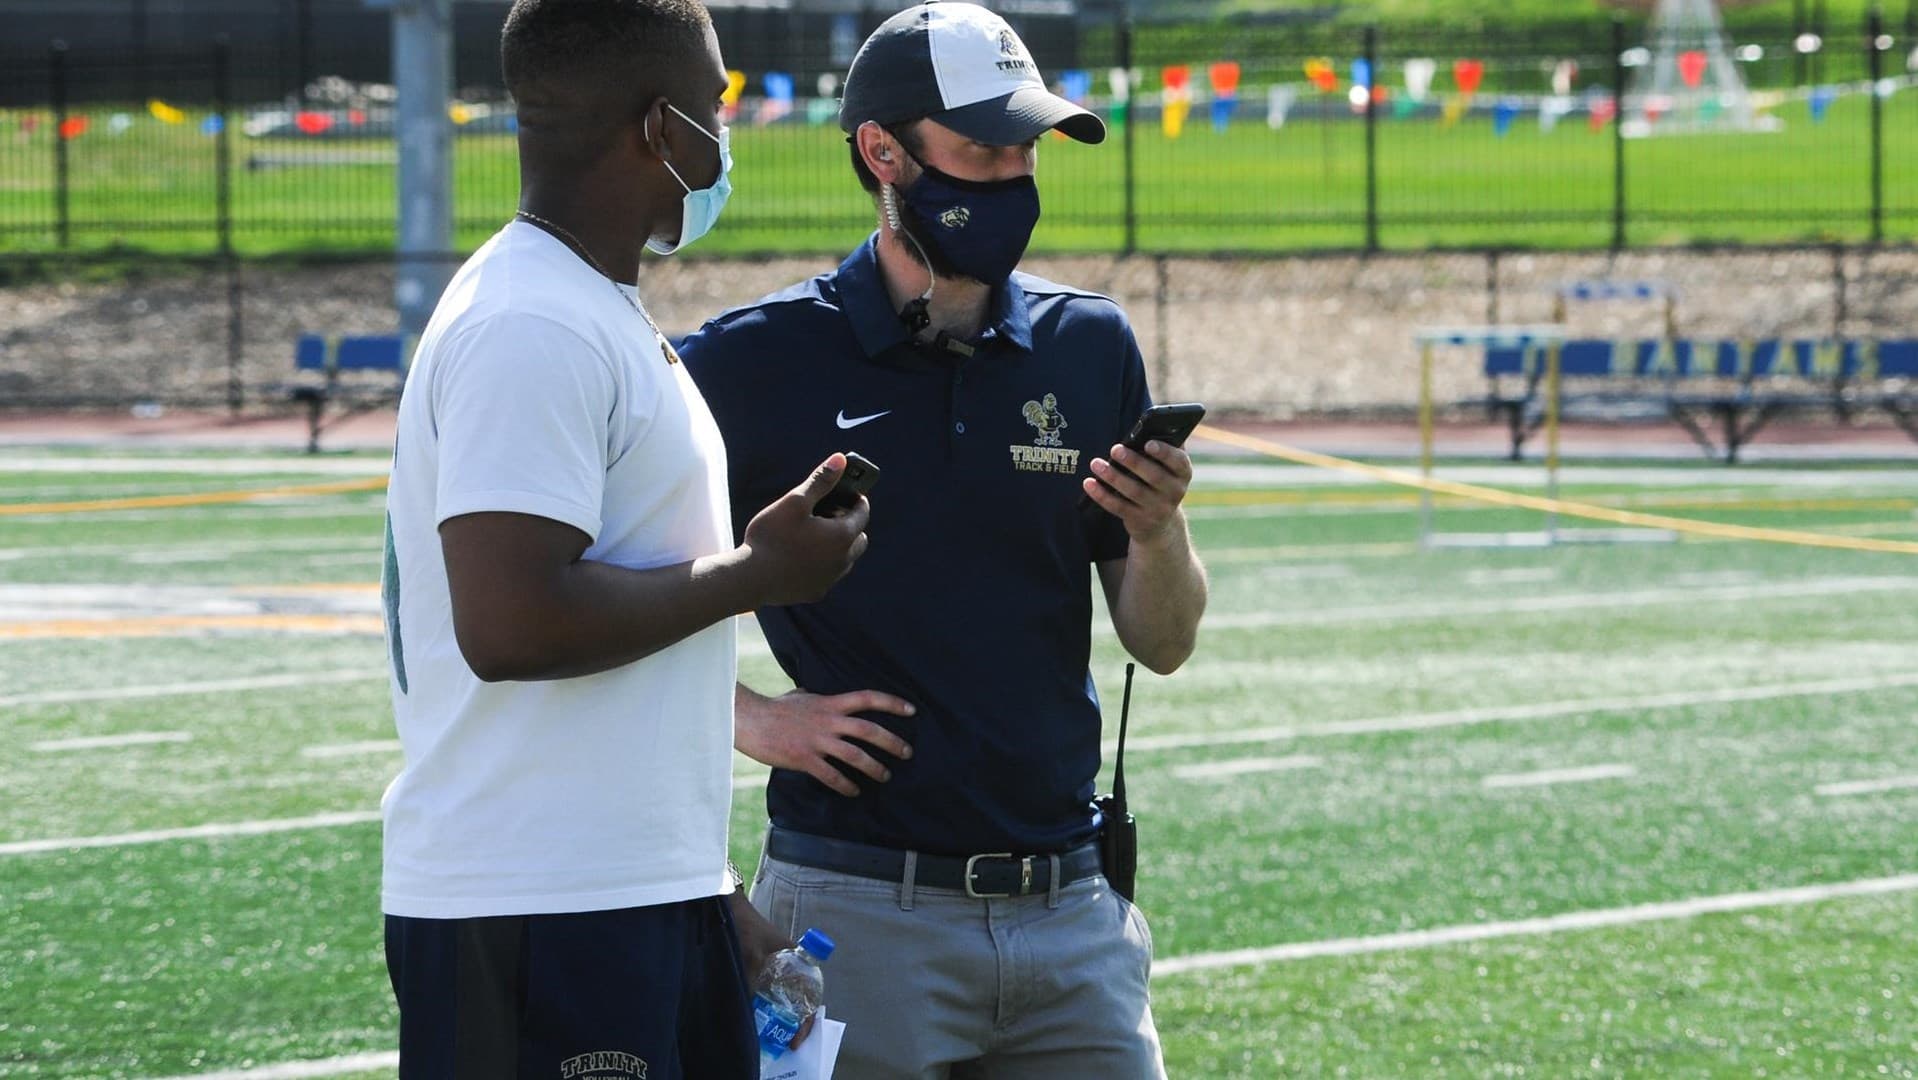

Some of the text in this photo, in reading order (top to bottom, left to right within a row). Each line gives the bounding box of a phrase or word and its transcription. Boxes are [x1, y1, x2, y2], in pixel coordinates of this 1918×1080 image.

[995, 60, 1035, 72] TRIN
[1009, 445, 1080, 465] TRINITY
[1015, 461, 1077, 474] TRACK & FIELD
[561, 1051, 648, 1079] TRINITY
